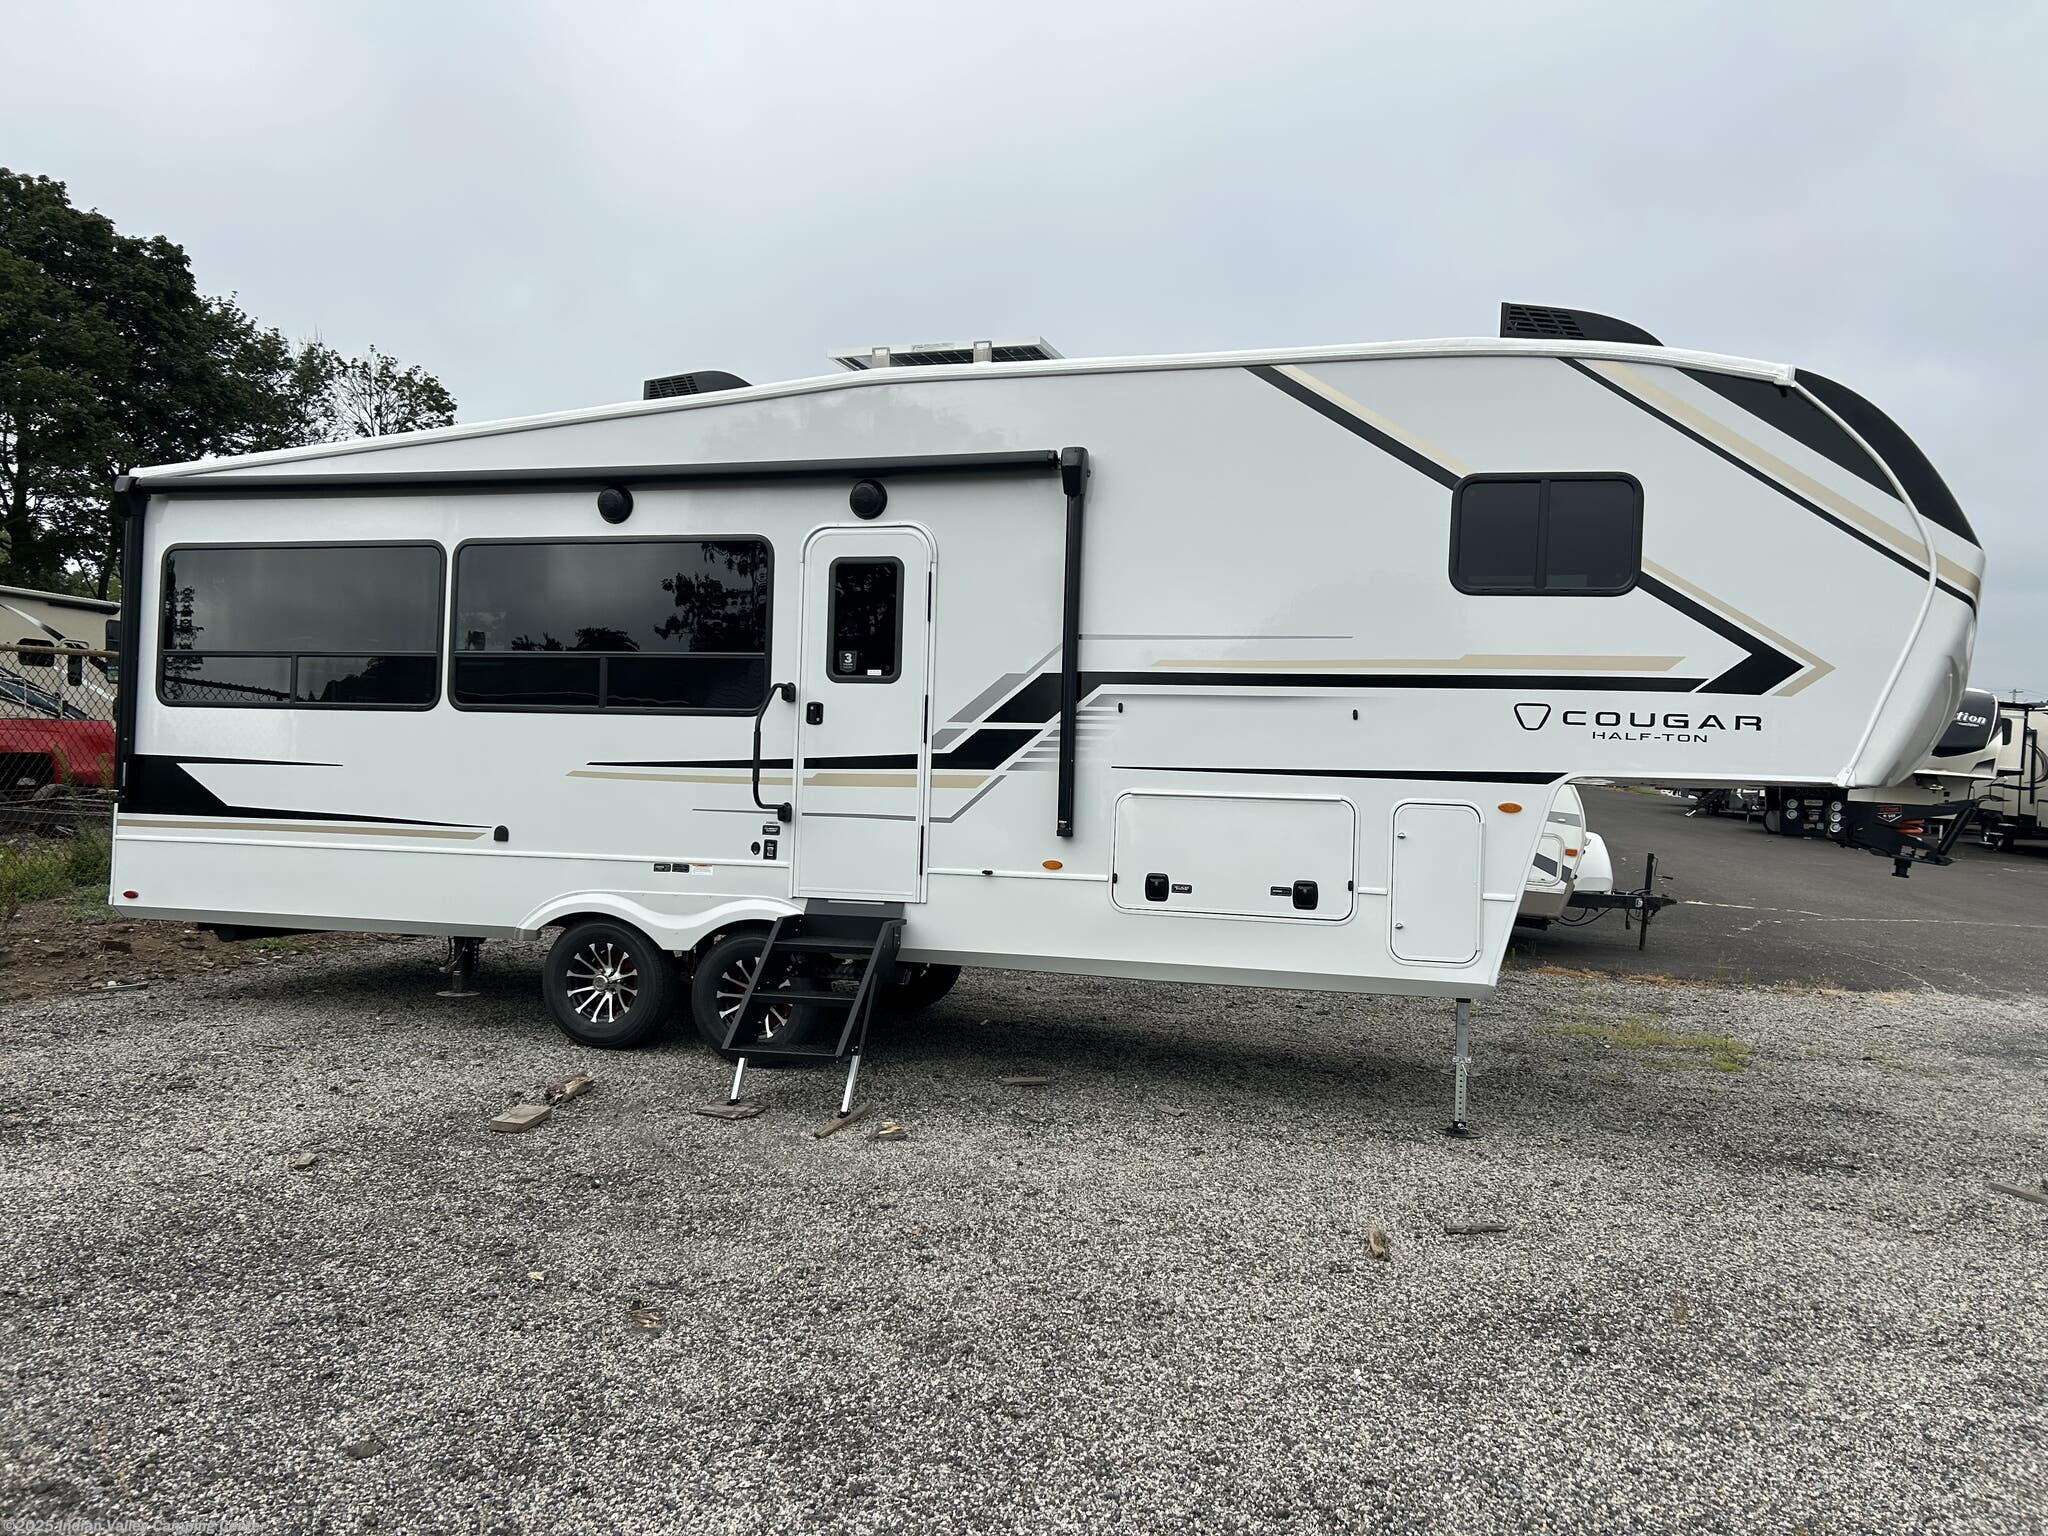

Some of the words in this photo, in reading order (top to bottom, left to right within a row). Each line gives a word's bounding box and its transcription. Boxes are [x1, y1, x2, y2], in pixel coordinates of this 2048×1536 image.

[844, 653, 853, 663] 3
[1562, 710, 1762, 731] COUGAR
[1592, 731, 1708, 743] HALF-TON
